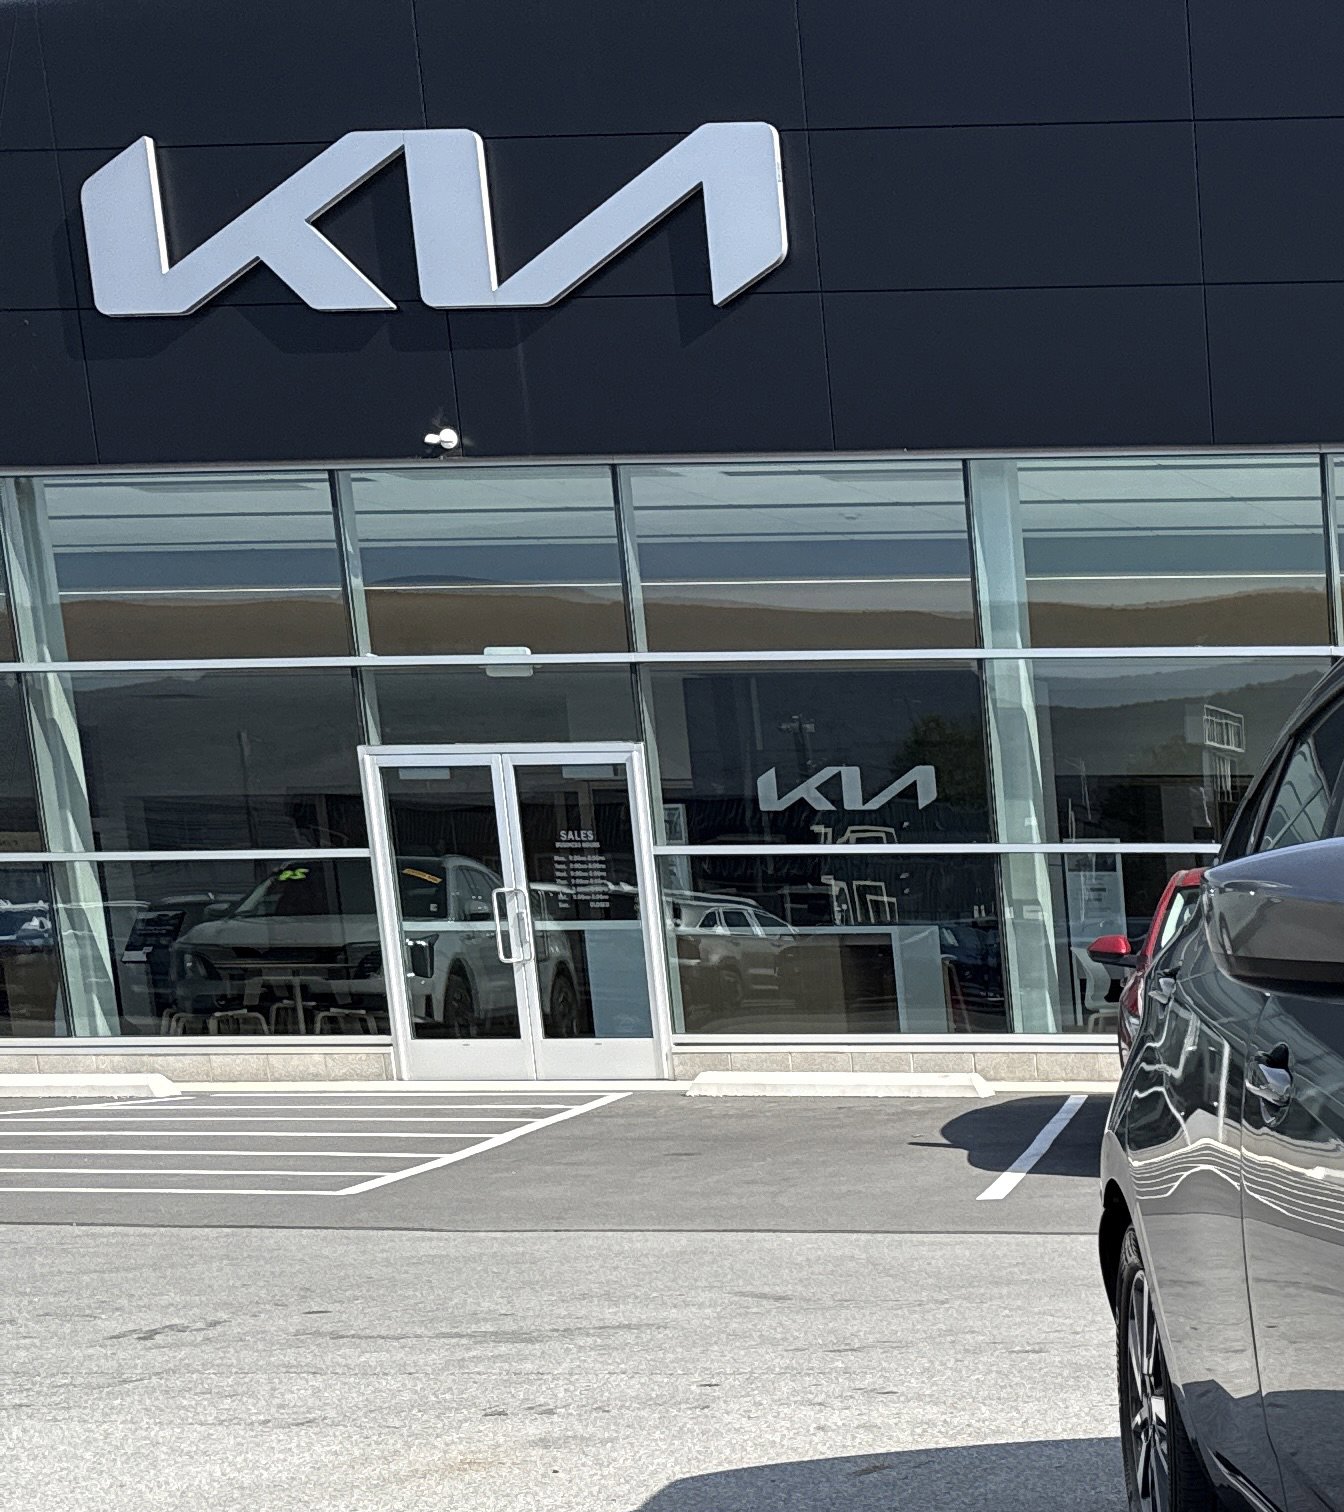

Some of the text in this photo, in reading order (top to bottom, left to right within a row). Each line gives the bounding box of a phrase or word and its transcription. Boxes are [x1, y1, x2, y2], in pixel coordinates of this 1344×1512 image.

[80, 120, 789, 318] KIA
[756, 765, 938, 812] KIA
[560, 830, 594, 840] SALES
